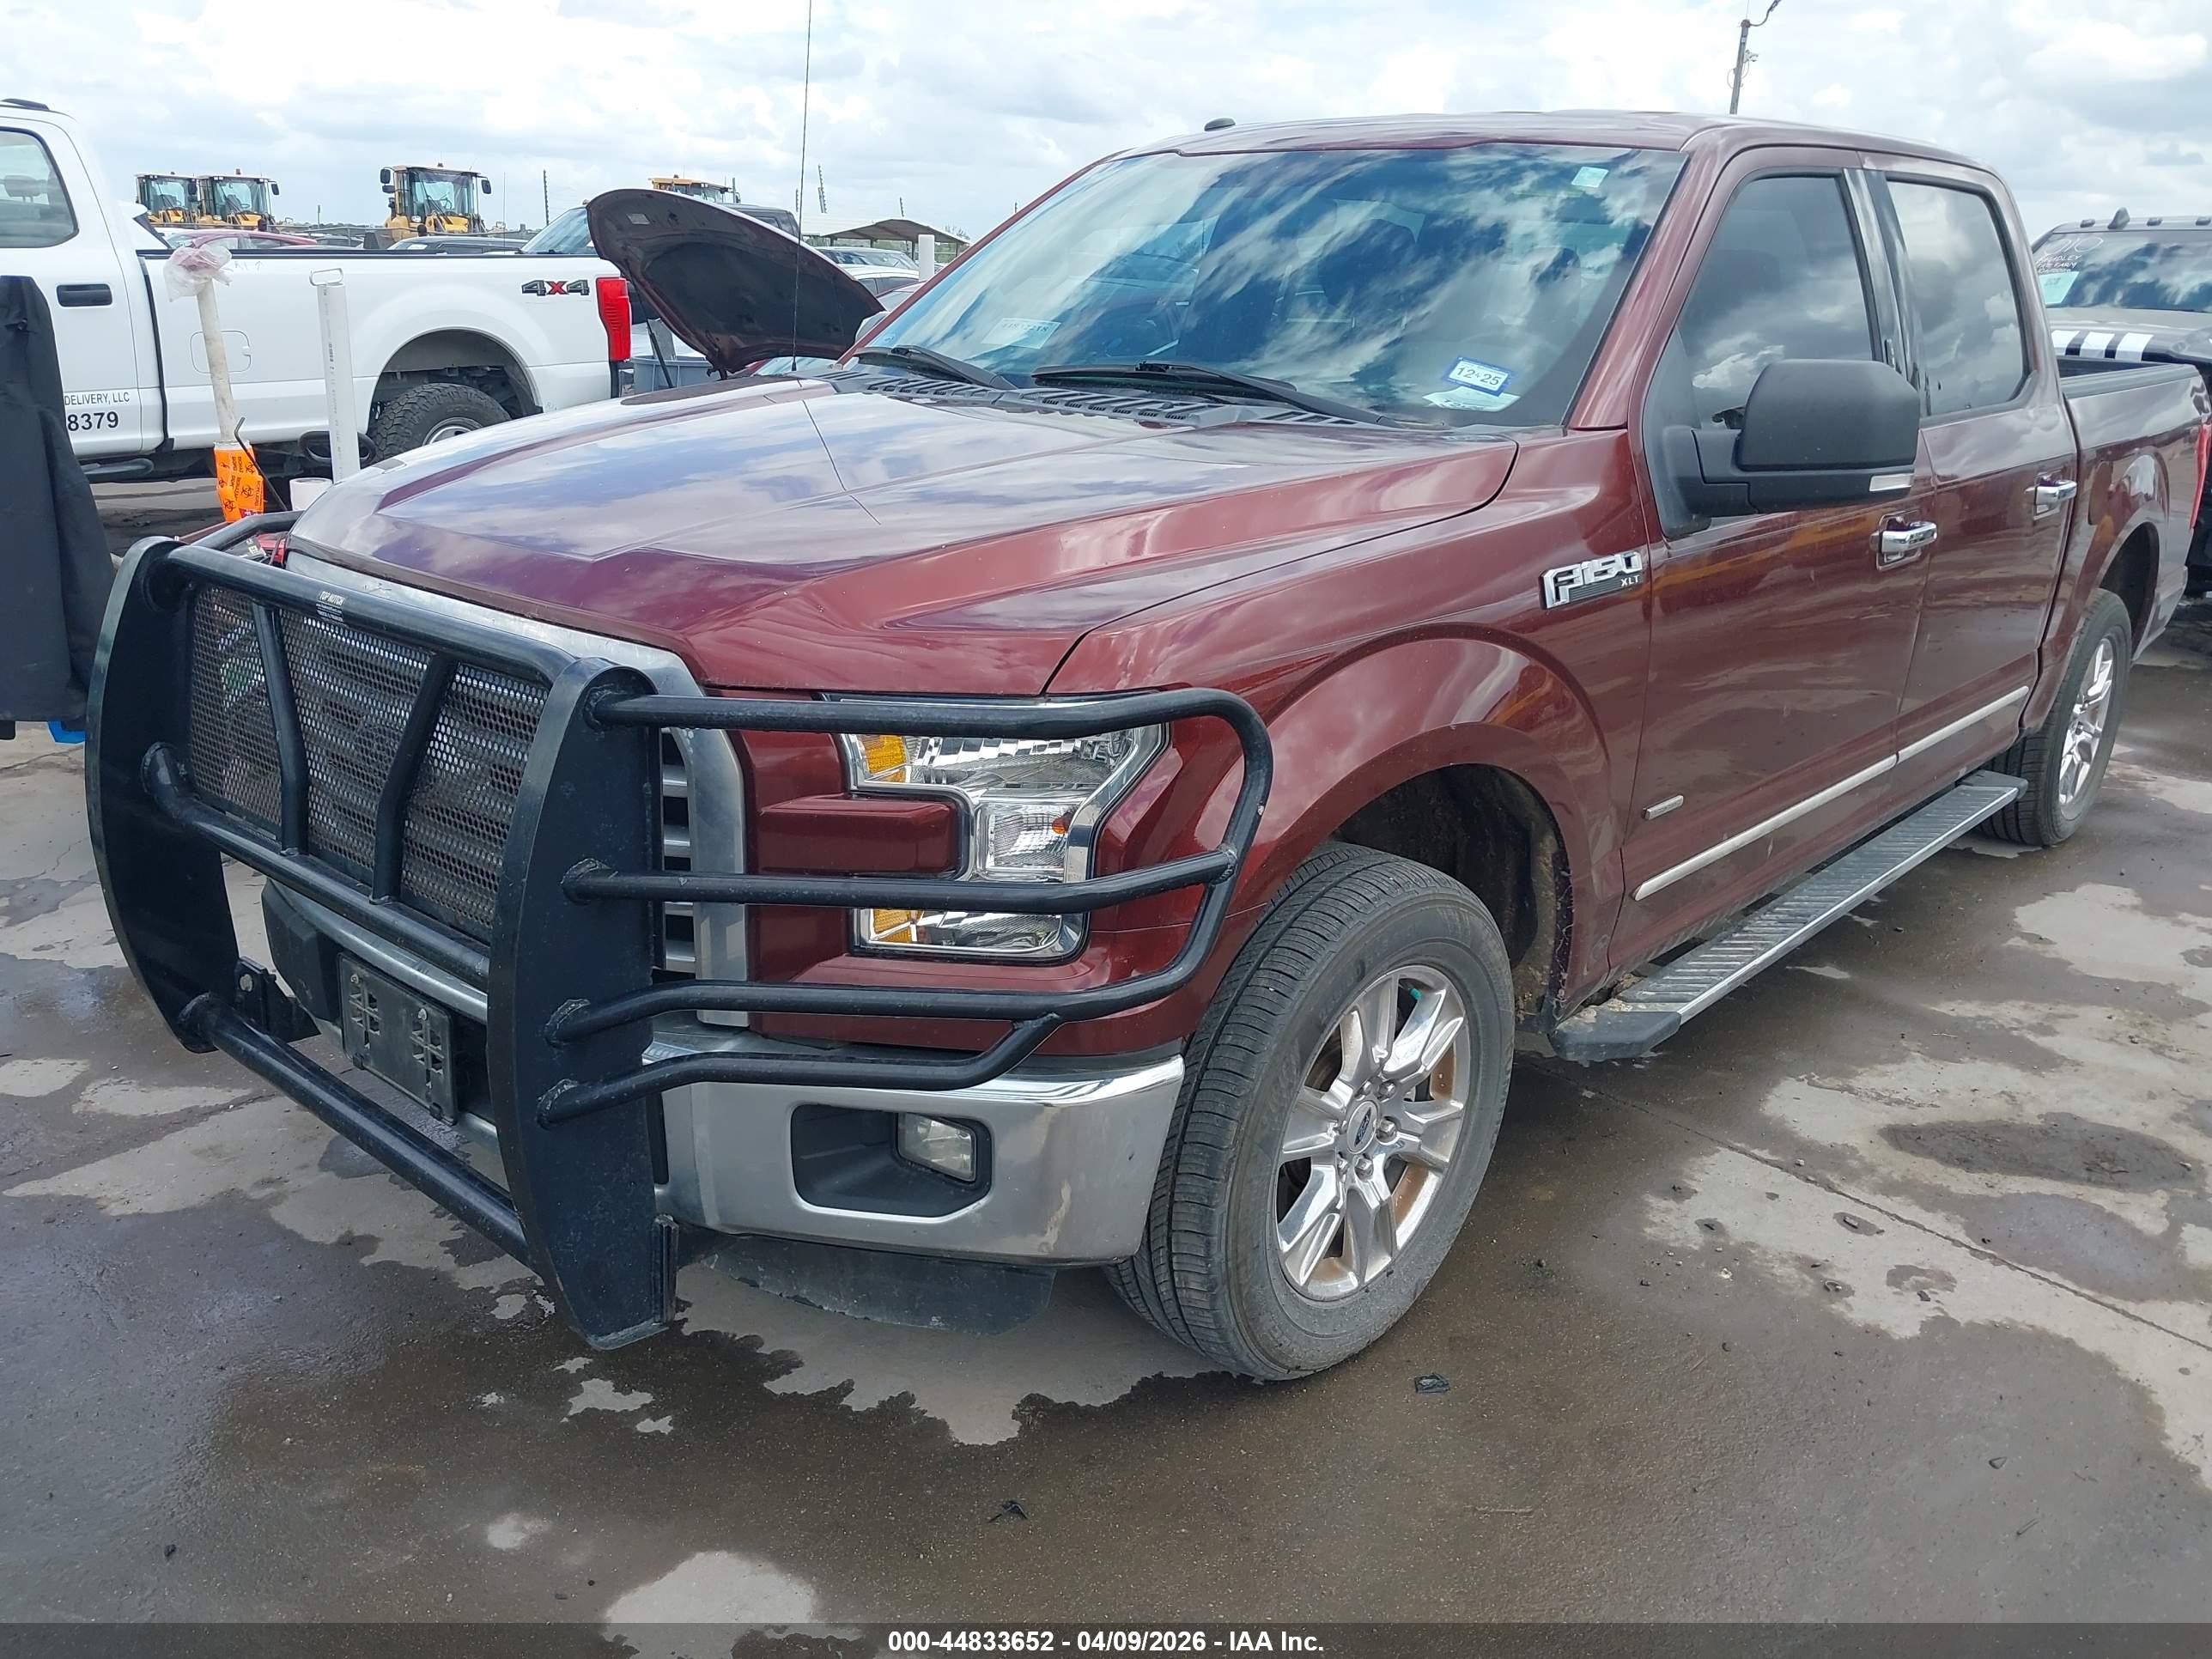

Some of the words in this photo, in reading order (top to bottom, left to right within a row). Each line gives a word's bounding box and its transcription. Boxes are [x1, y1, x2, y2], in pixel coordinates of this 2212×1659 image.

[64, 393, 111, 405] DELIVERY,
[112, 392, 130, 403] LLC
[67, 410, 119, 431] 8379
[1620, 574, 1640, 587] XLT
